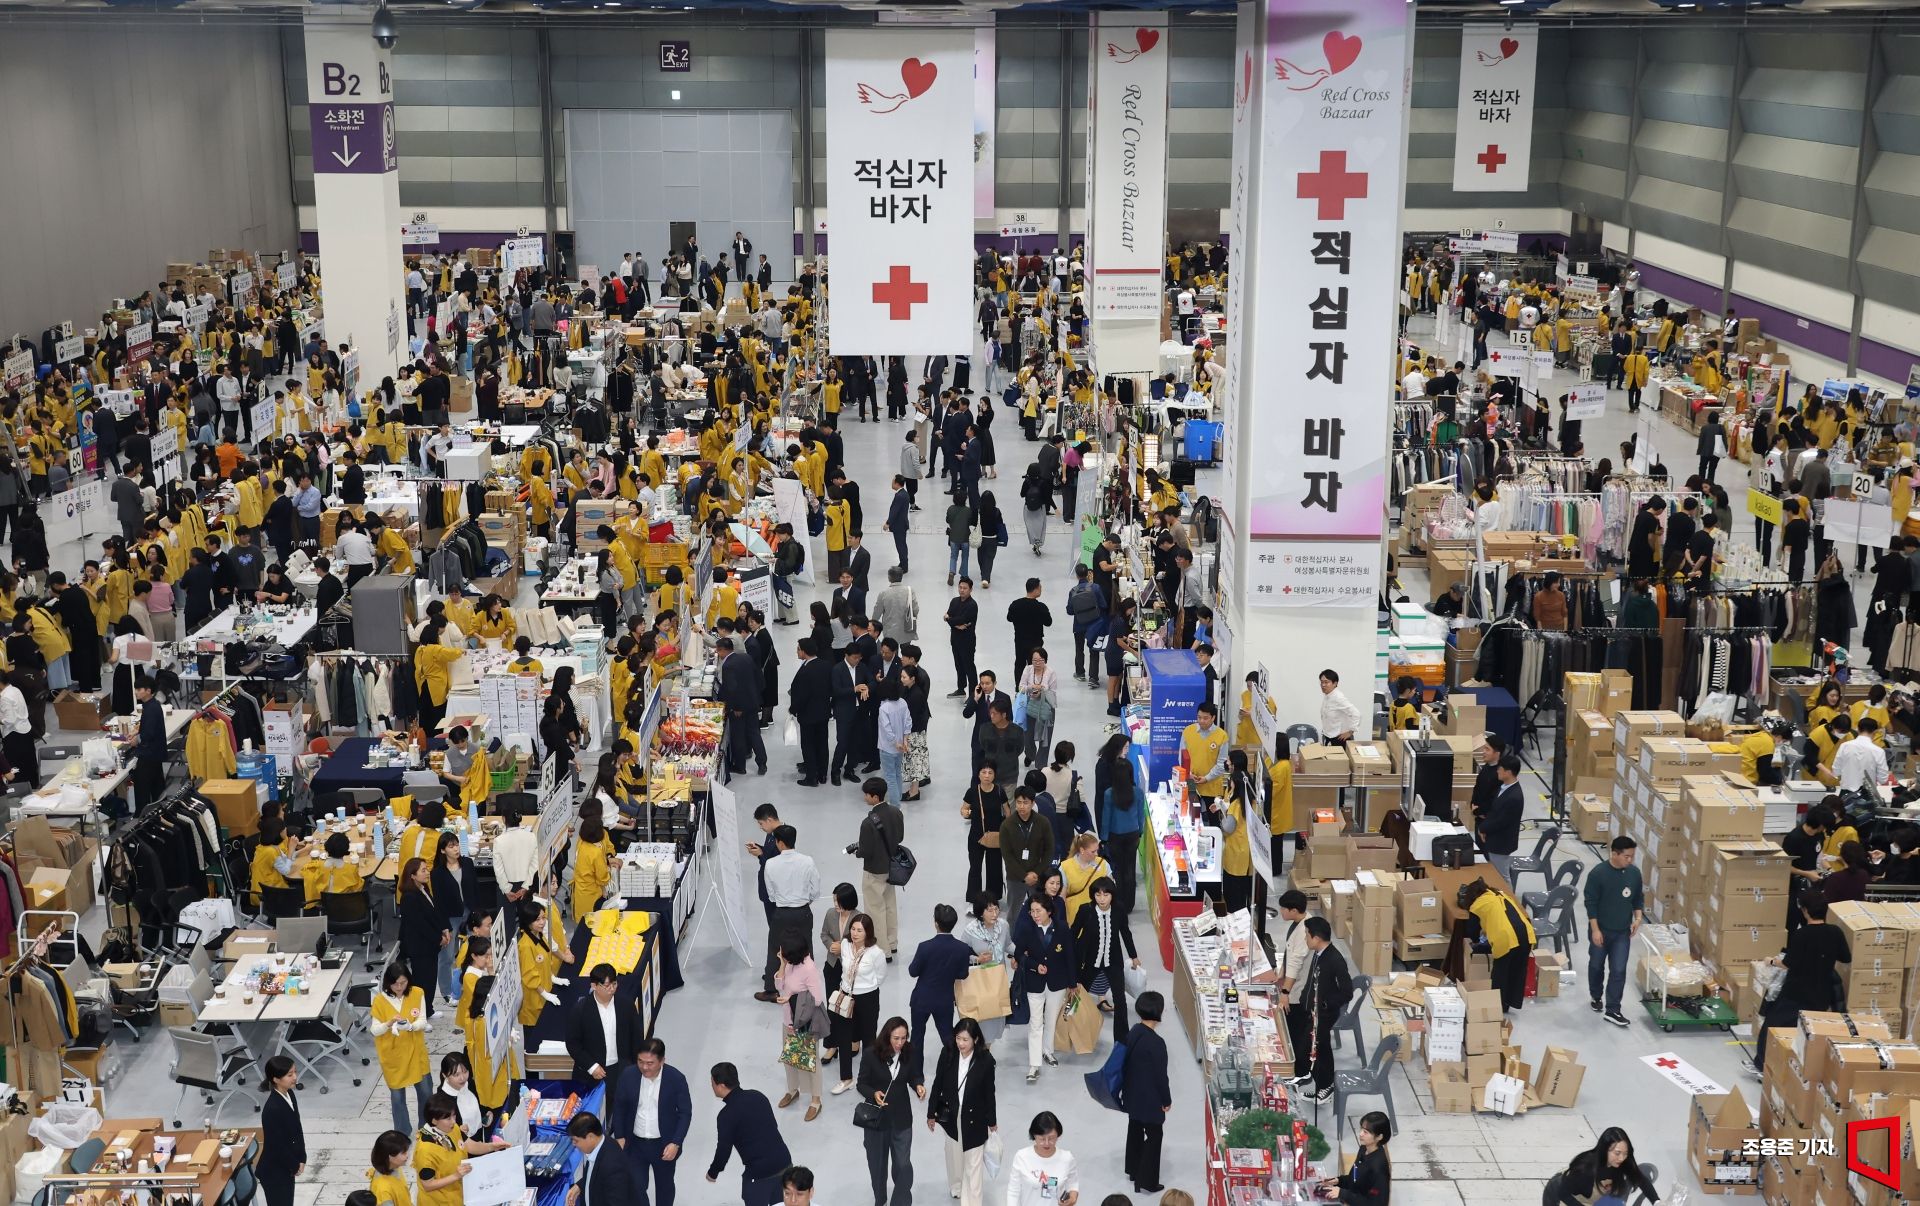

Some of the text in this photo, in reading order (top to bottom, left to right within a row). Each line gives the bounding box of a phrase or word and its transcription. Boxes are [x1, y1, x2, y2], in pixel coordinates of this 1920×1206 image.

[681, 48, 689, 61] 2
[323, 62, 361, 95] B2
[379, 61, 390, 94] B2
[1321, 87, 1391, 103] Red Cross
[1472, 89, 1520, 105] 적십자
[324, 109, 365, 125] 소화전
[1319, 106, 1374, 119] Bazaar
[1479, 107, 1512, 123] 바자
[853, 158, 947, 189] 적십자
[1121, 84, 1143, 253] Red Cross Bazaar
[870, 193, 931, 225] 바자
[415, 213, 426, 222] 68
[1015, 214, 1026, 222] 38
[518, 226, 527, 235] 67
[1461, 228, 1471, 236] 10
[1580, 264, 1585, 272] 7
[1513, 332, 1527, 344] 15
[1300, 231, 1351, 513] 적십자 바자
[72, 451, 81, 469] 60
[1760, 472, 1769, 486] 19
[1855, 476, 1870, 494] 20
[1755, 497, 1772, 517] kakao
[1258, 554, 1353, 564] 주관 대한적십자사 본사
[1294, 566, 1370, 575] 여성봉사특별자문위원회
[1256, 584, 1372, 595] 후원 대한적십자사 수요봉사회
[545, 763, 555, 792] 53
[494, 919, 504, 960] 54
